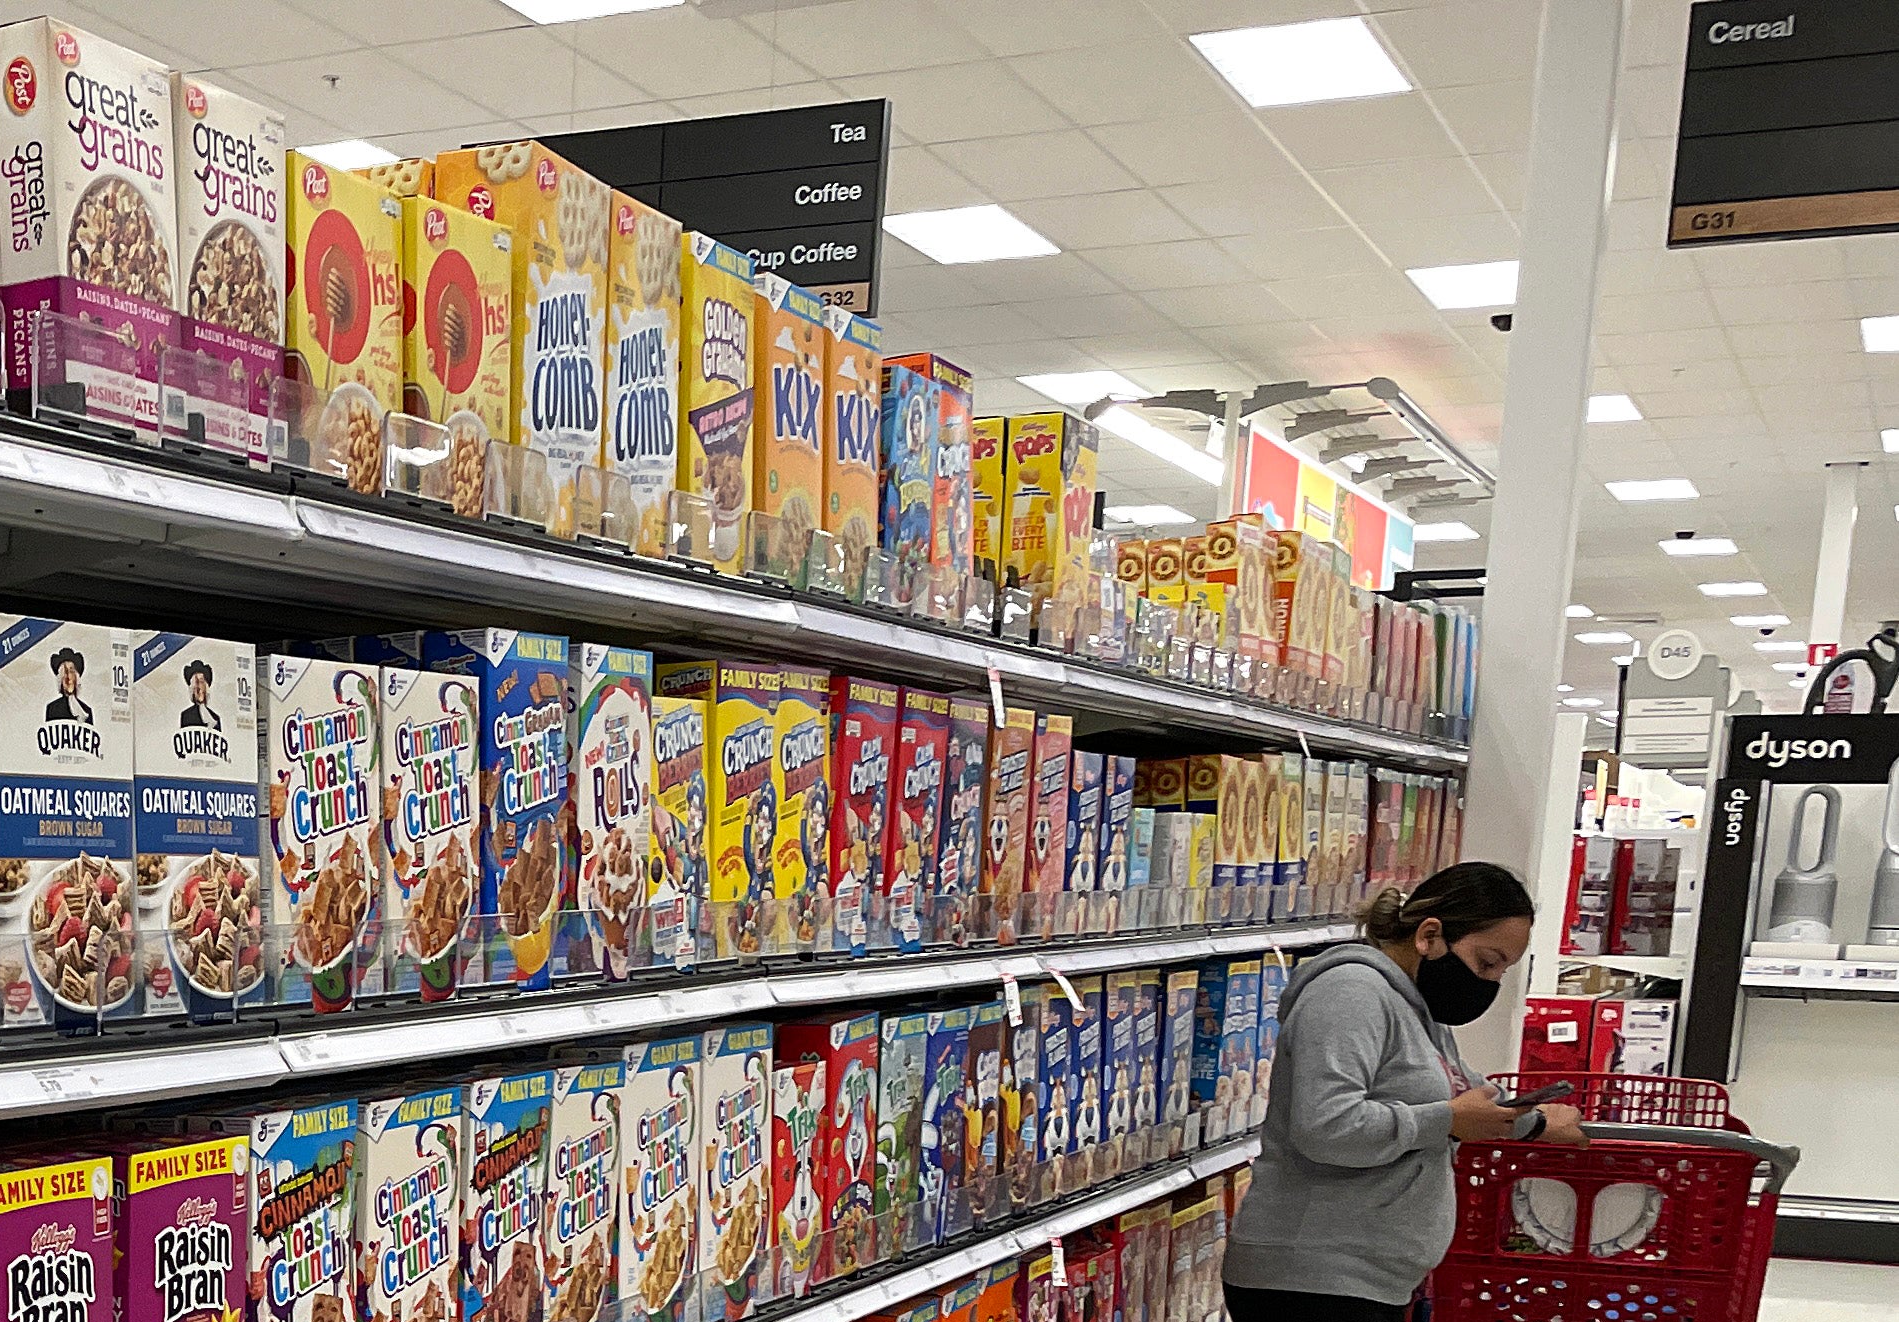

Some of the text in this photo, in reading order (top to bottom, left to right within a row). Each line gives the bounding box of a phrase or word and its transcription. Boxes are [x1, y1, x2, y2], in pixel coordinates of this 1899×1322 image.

[1708, 16, 1795, 44] Cereal
[8, 60, 34, 109] Post
[65, 71, 139, 137] great
[76, 118, 163, 179] grains
[831, 123, 866, 145] Tea
[192, 124, 255, 183] great
[16, 141, 49, 239] great
[303, 167, 328, 196] Post
[795, 181, 862, 206] Coffee
[1, 150, 31, 254] grains
[1690, 211, 1735, 231] G31
[790, 242, 858, 266] Coffee
[775, 367, 820, 450] KIX
[1013, 434, 1056, 465] POPS
[1012, 536, 1045, 551] BITE
[1661, 645, 1691, 660] D45
[721, 669, 757, 689] FAMILY
[37, 720, 101, 757] QUAKER
[285, 704, 368, 761] Cinnamon
[1746, 731, 1852, 768] dyson
[302, 743, 355, 793] Toast
[1, 786, 130, 817] OATMEAL SQUARES
[293, 778, 369, 844] Crunch
[1725, 788, 1750, 846] dyson
[399, 1094, 453, 1125] FAMILY SIZE
[375, 1158, 449, 1224] Cinnamon
